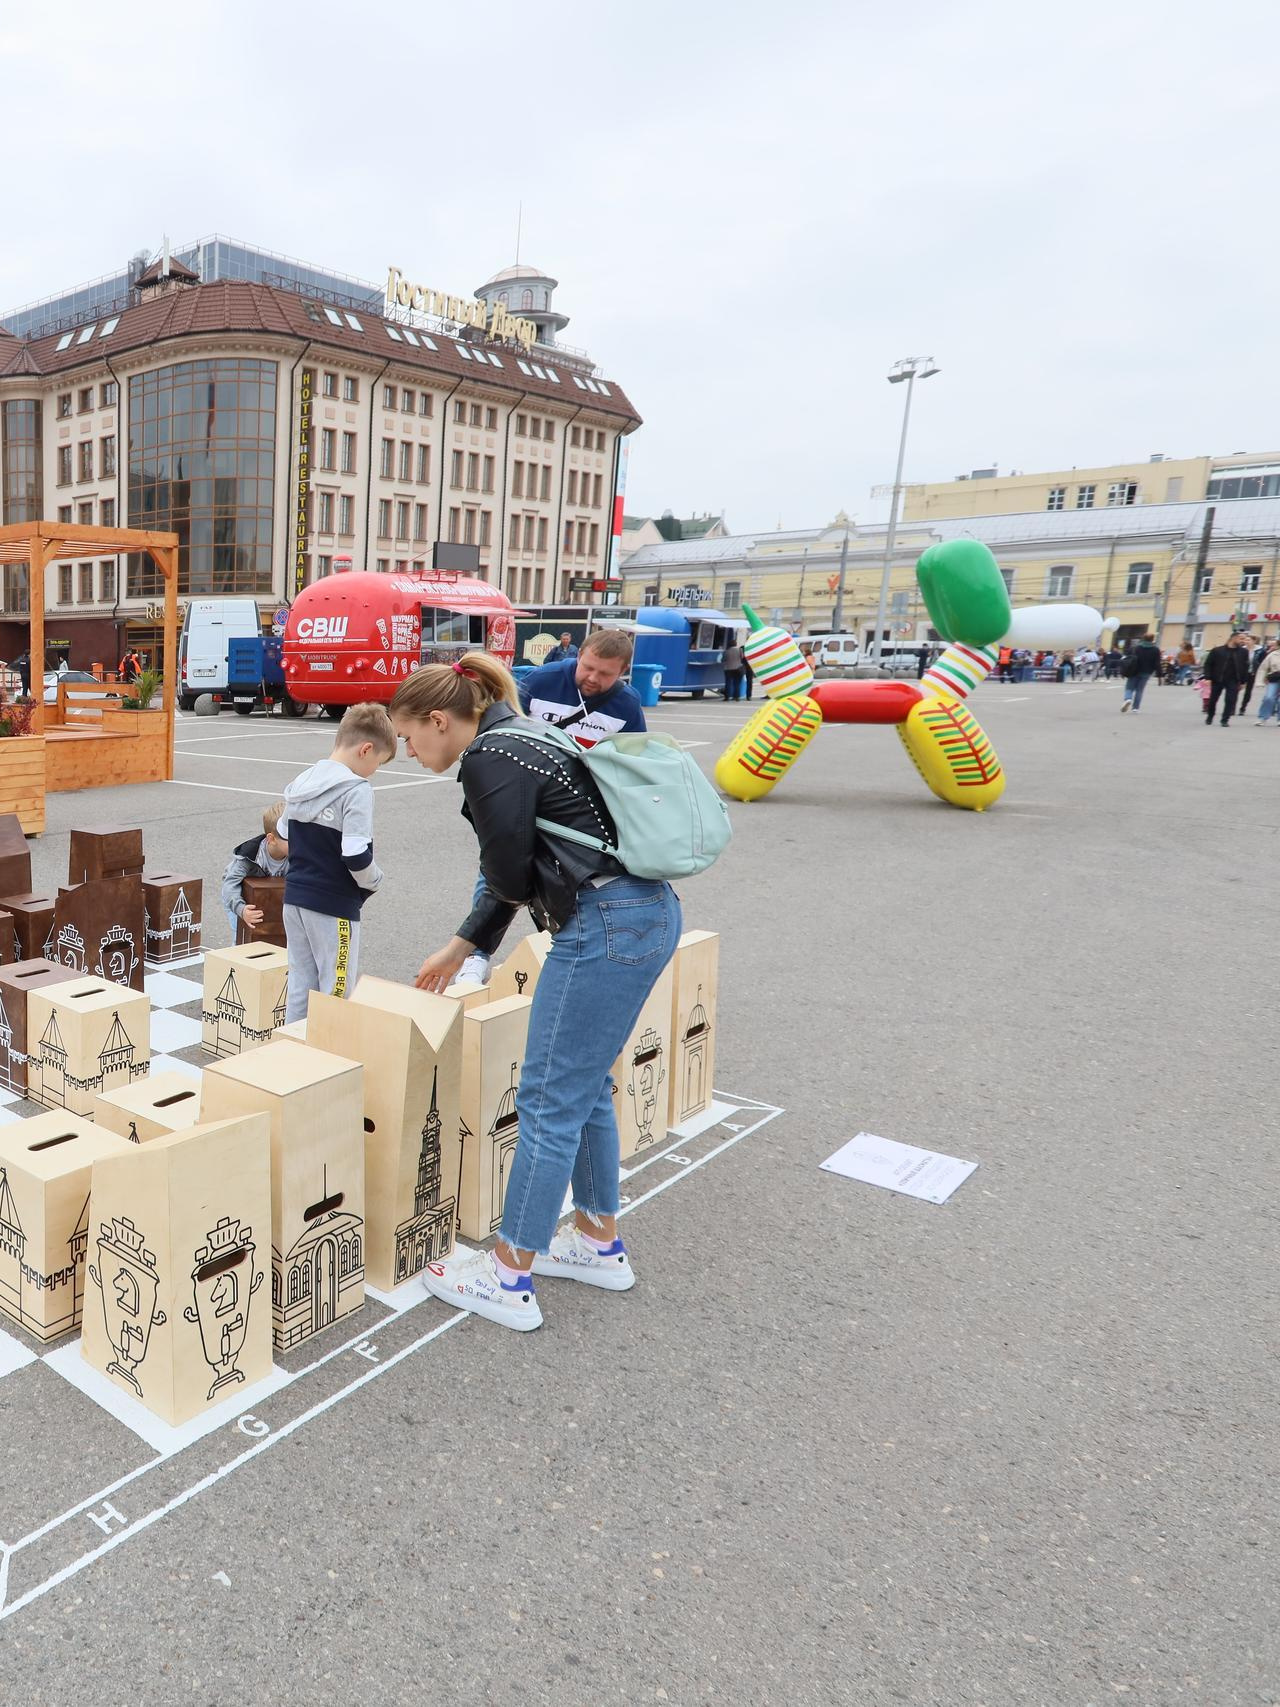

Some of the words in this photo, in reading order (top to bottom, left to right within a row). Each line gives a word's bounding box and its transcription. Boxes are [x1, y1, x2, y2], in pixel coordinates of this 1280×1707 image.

[301, 373, 311, 445] HOTEL
[296, 453, 308, 593] RESTAURANT
[297, 616, 349, 638] СВШ
[339, 921, 349, 932] BE
[336, 976, 346, 988] BE
[720, 1121, 746, 1133] A
[664, 1154, 693, 1166] B
[352, 1340, 380, 1363] F
[237, 1414, 270, 1437] G
[86, 1501, 128, 1535] H
